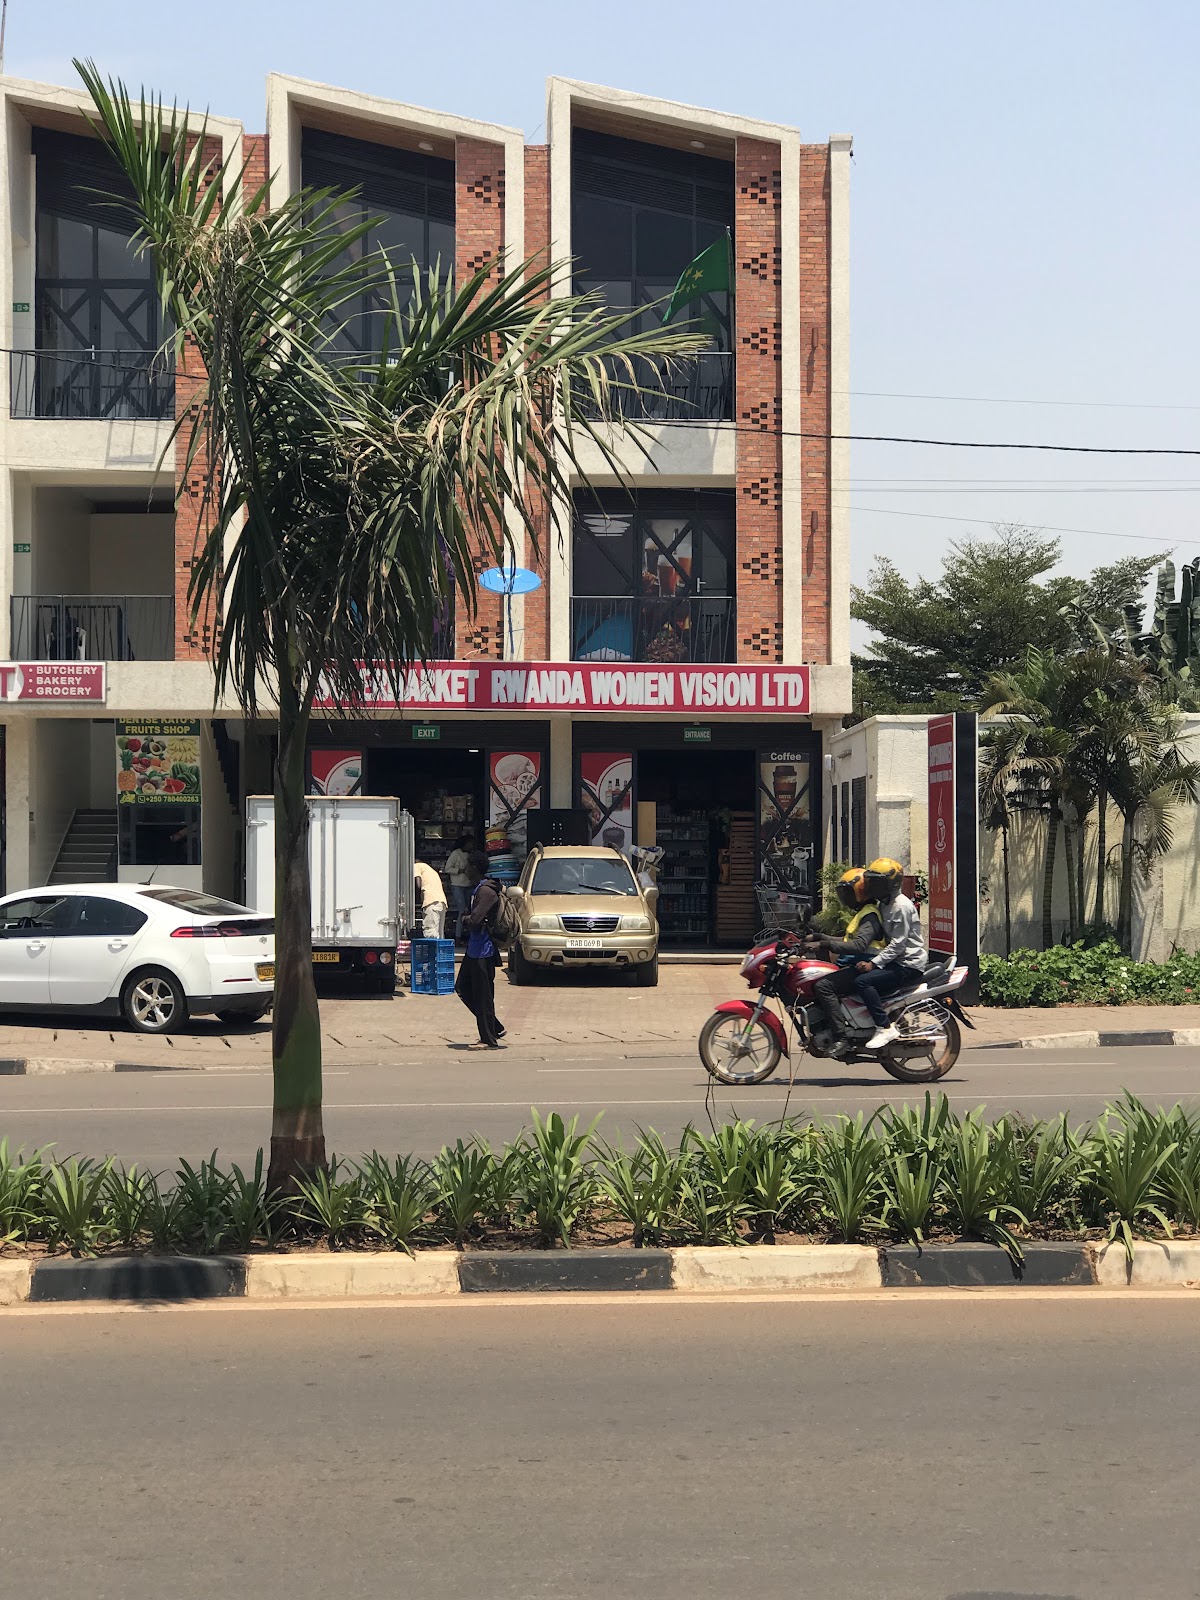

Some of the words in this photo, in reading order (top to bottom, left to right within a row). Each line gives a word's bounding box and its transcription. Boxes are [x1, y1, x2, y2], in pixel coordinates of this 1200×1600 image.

[36, 666, 97, 675] BUTCHERY
[36, 676, 82, 685] BAKERY
[36, 687, 92, 696] GROCERY
[491, 669, 586, 705] RWANDA
[590, 670, 674, 706] WOMEN
[679, 671, 756, 707] VISION
[761, 672, 804, 707] LTD
[125, 726, 160, 734] FRUITS
[163, 726, 191, 734] SHOP
[417, 728, 436, 738] EXIT
[685, 731, 710, 739] ENTRANCE
[770, 752, 802, 761] Coffee
[570, 939, 583, 947] RAB
